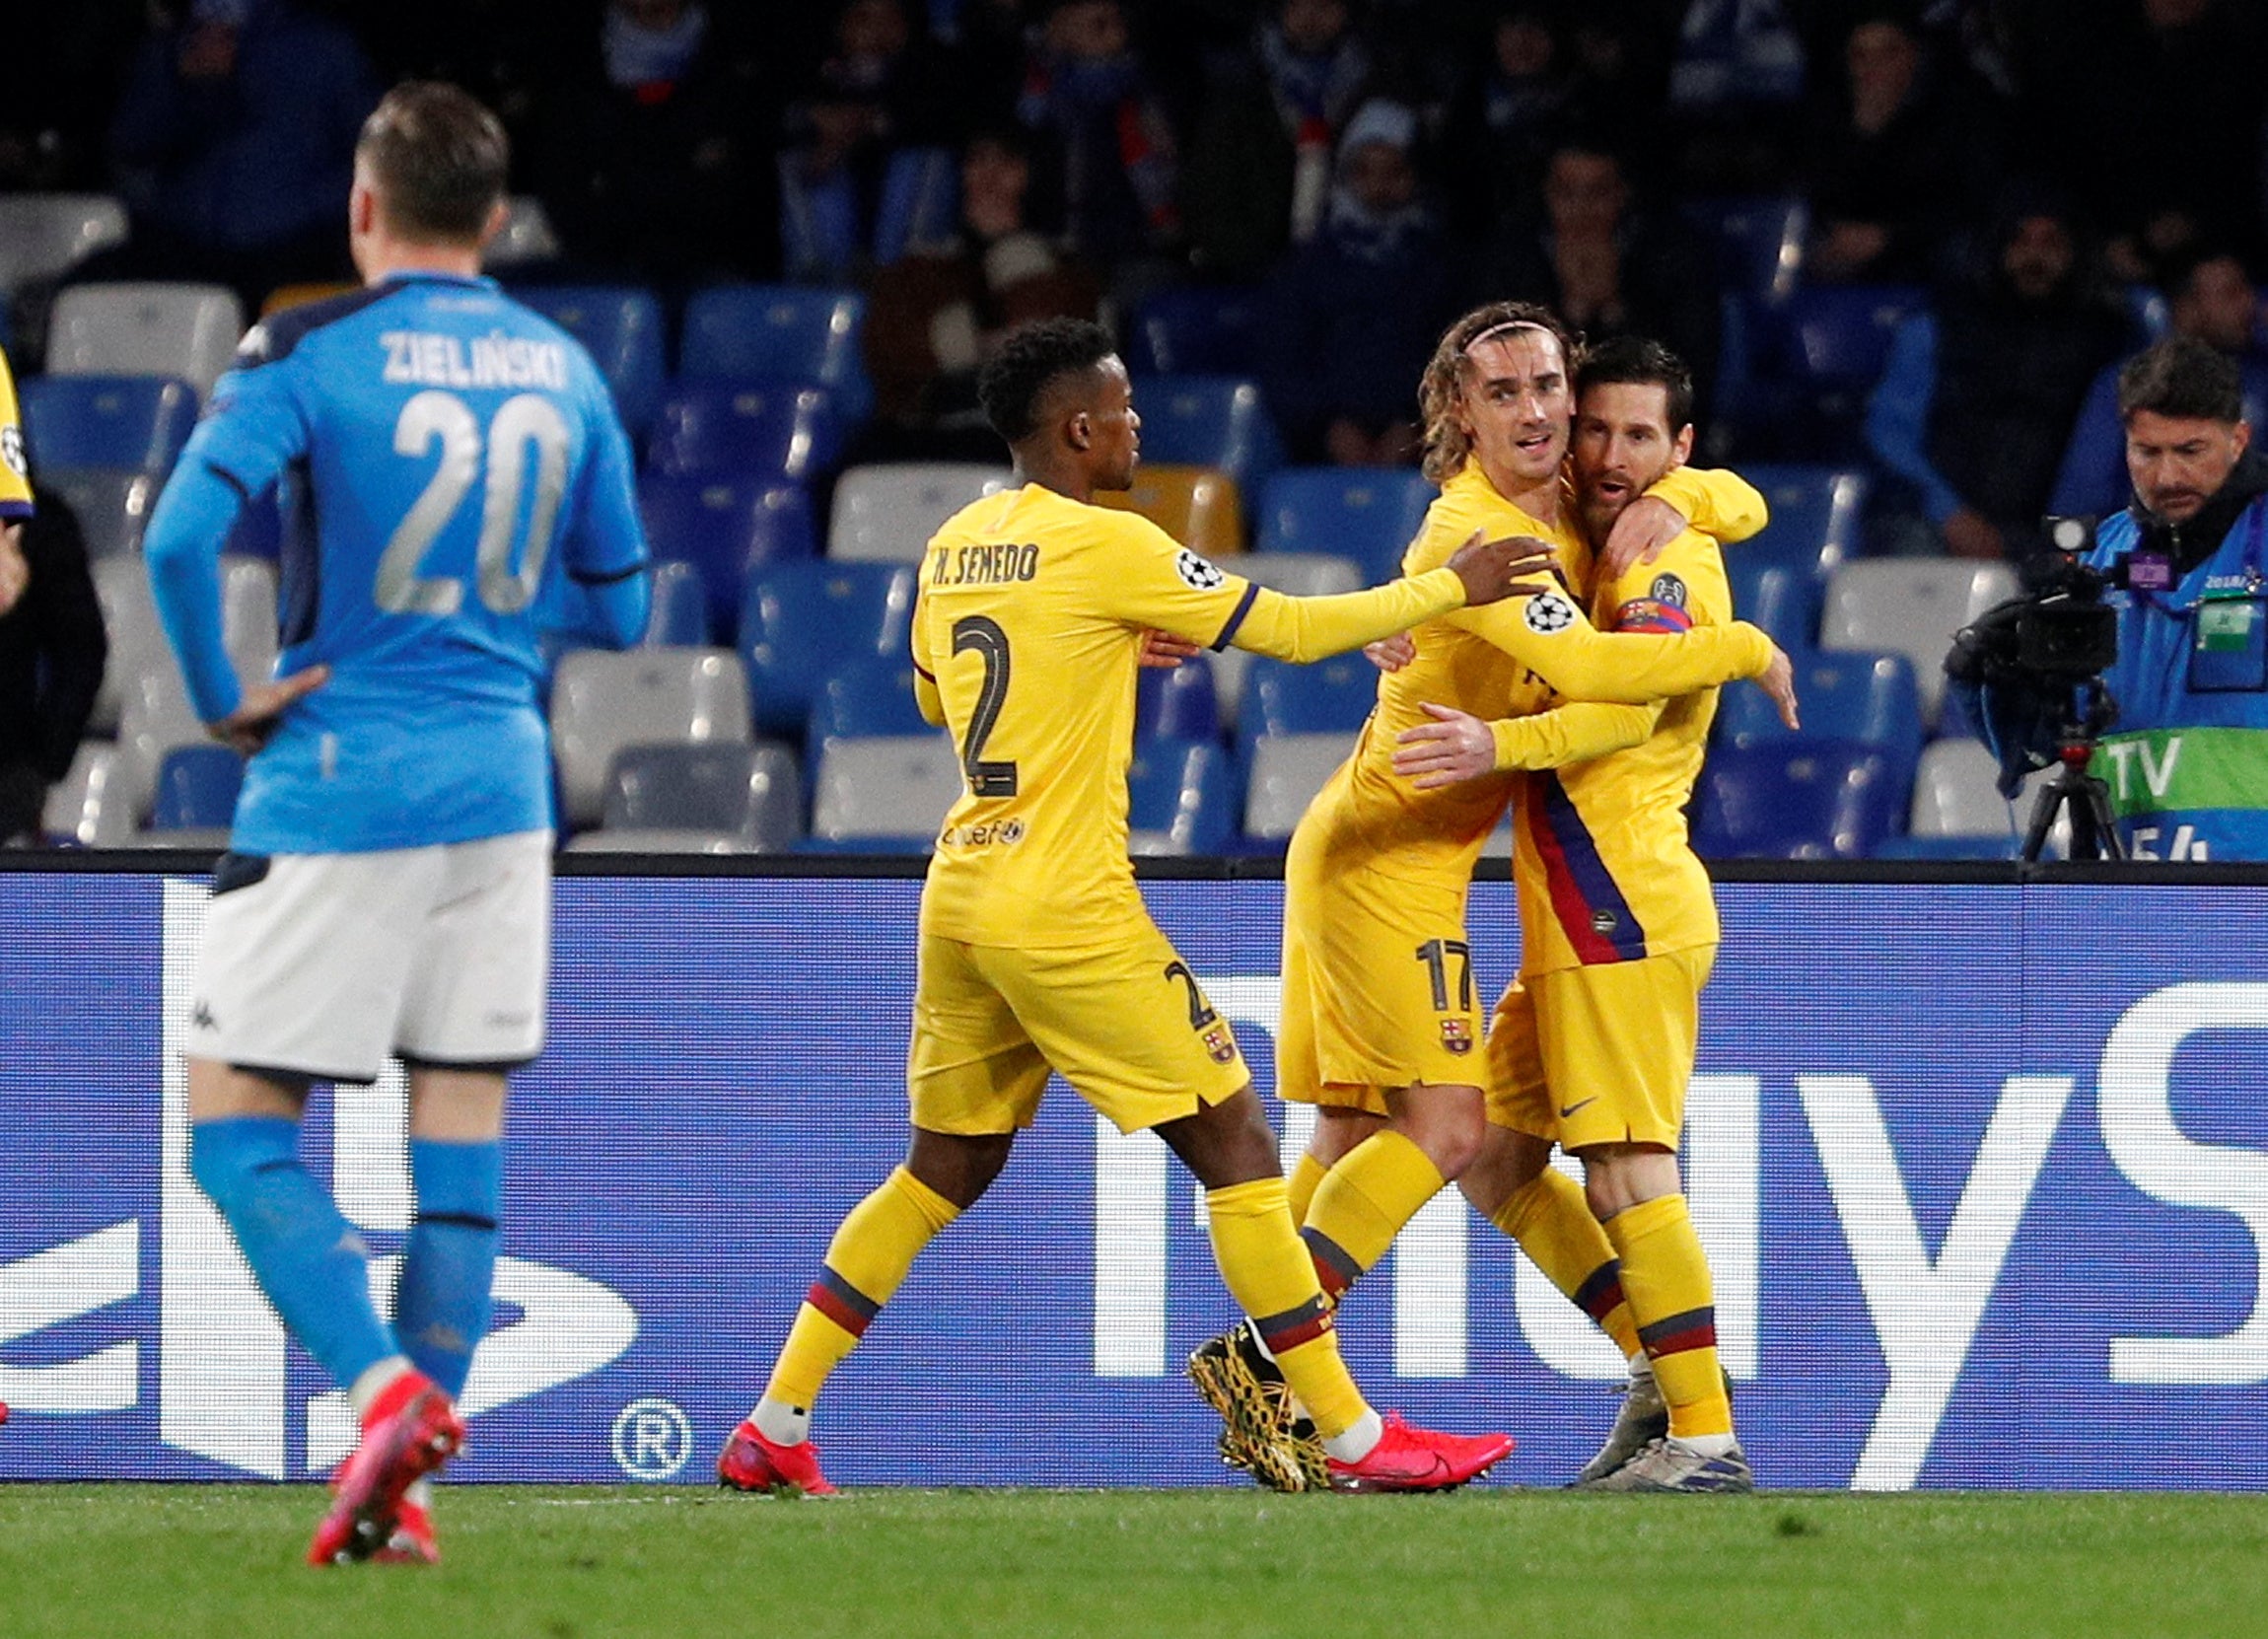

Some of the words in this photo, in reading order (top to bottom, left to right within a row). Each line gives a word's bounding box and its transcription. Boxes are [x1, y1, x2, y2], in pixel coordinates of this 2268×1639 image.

[380, 329, 568, 391] ZIELIŃSKI
[374, 390, 568, 615] 20
[954, 543, 1039, 585] SEMEDO
[952, 614, 1017, 797] 2
[2107, 737, 2181, 801] TV
[1164, 961, 1218, 1032] 2
[1416, 939, 1471, 1013] 17
